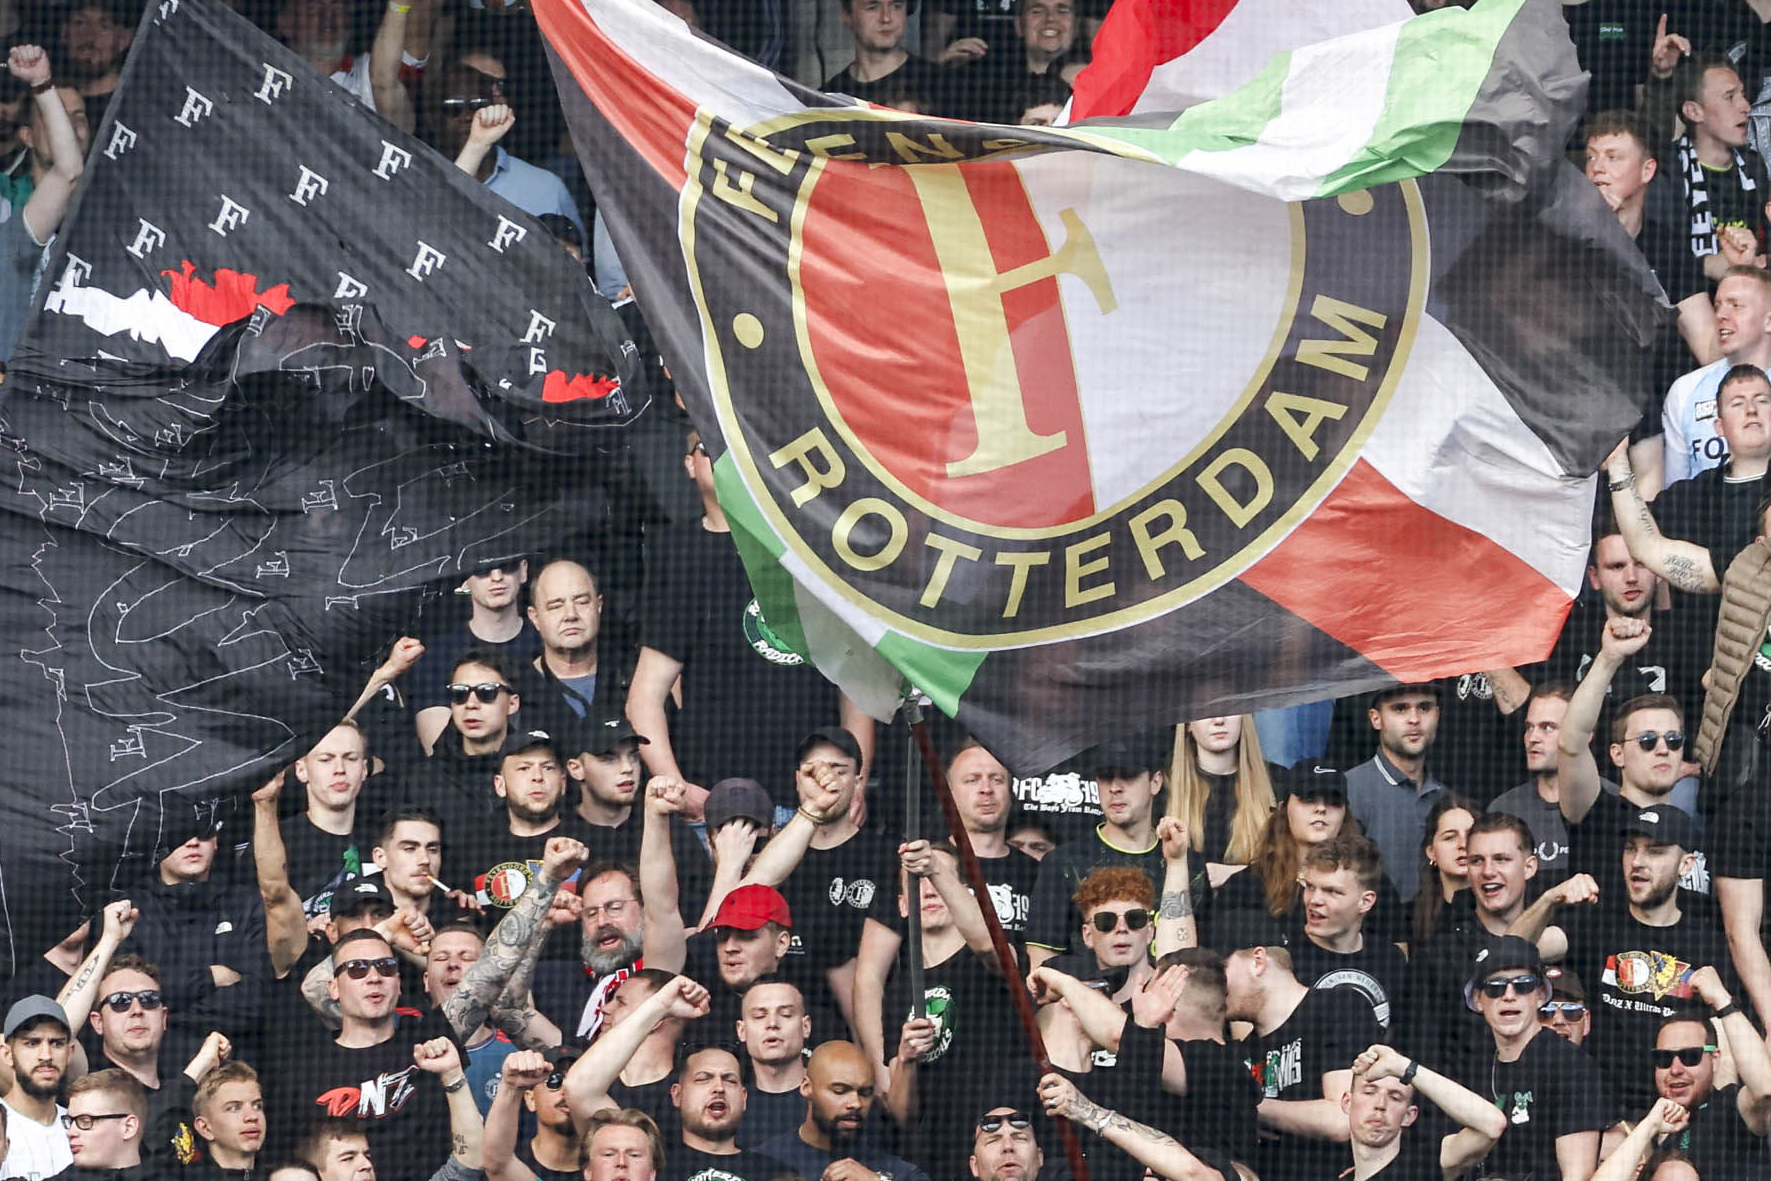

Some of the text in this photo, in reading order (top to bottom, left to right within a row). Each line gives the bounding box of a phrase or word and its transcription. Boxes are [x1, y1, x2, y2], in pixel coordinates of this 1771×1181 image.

[254, 62, 293, 105] F
[174, 85, 213, 128] F
[104, 120, 137, 160] F
[371, 140, 412, 181] F
[289, 164, 328, 207] F
[208, 194, 250, 237] F
[487, 214, 527, 253] F
[127, 217, 167, 259] F
[406, 240, 446, 282] F
[520, 308, 556, 344] F
[767, 293, 1388, 619] ROTTERDAM
